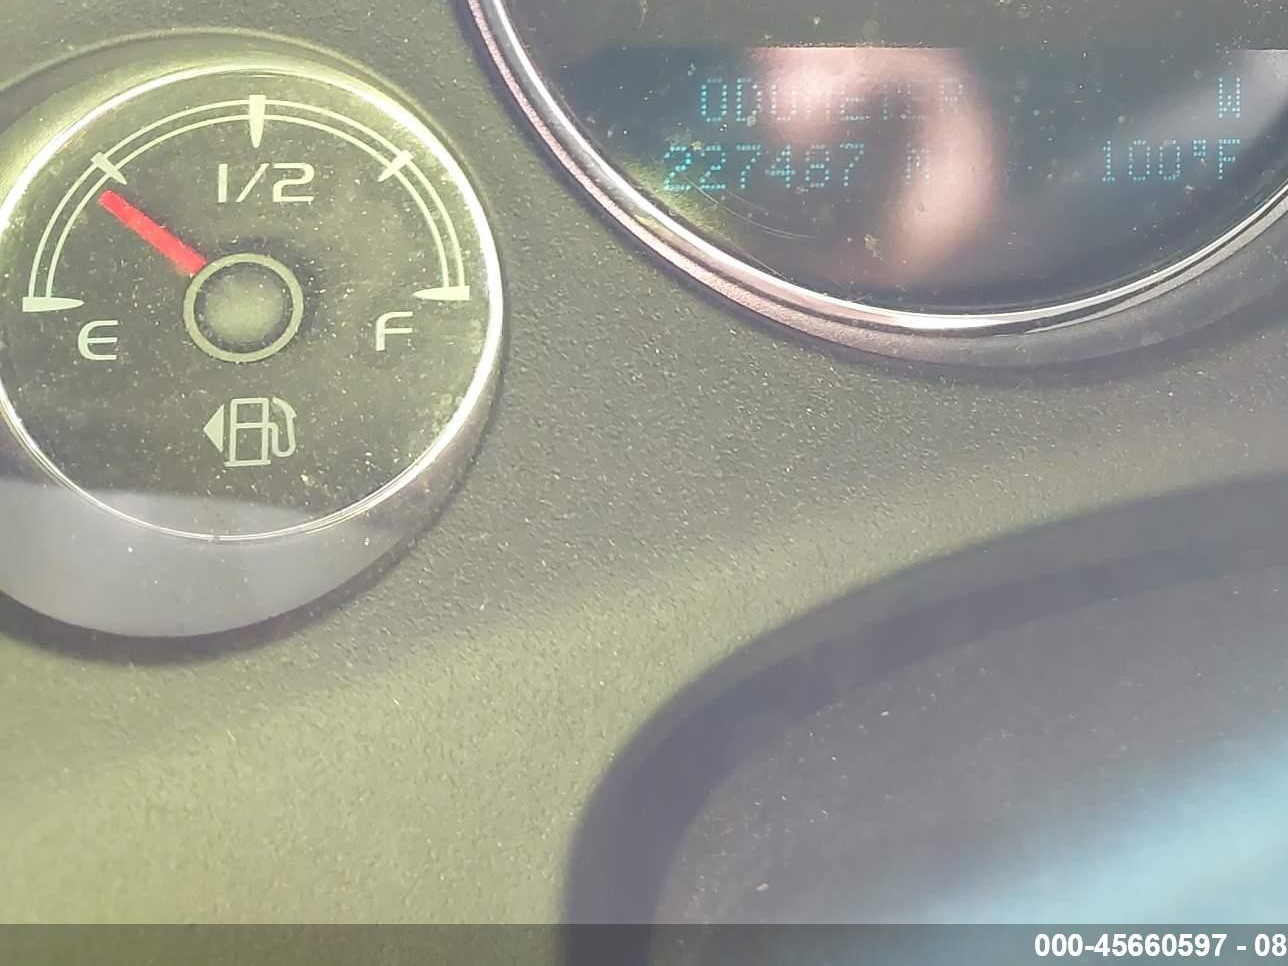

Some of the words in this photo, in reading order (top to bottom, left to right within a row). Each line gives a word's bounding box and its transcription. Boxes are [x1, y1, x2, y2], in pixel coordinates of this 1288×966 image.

[1217, 77, 1242, 119] W
[217, 162, 316, 204] 1/2
[662, 142, 866, 191] 227487
[77, 319, 119, 361] E
[375, 310, 414, 352] F
